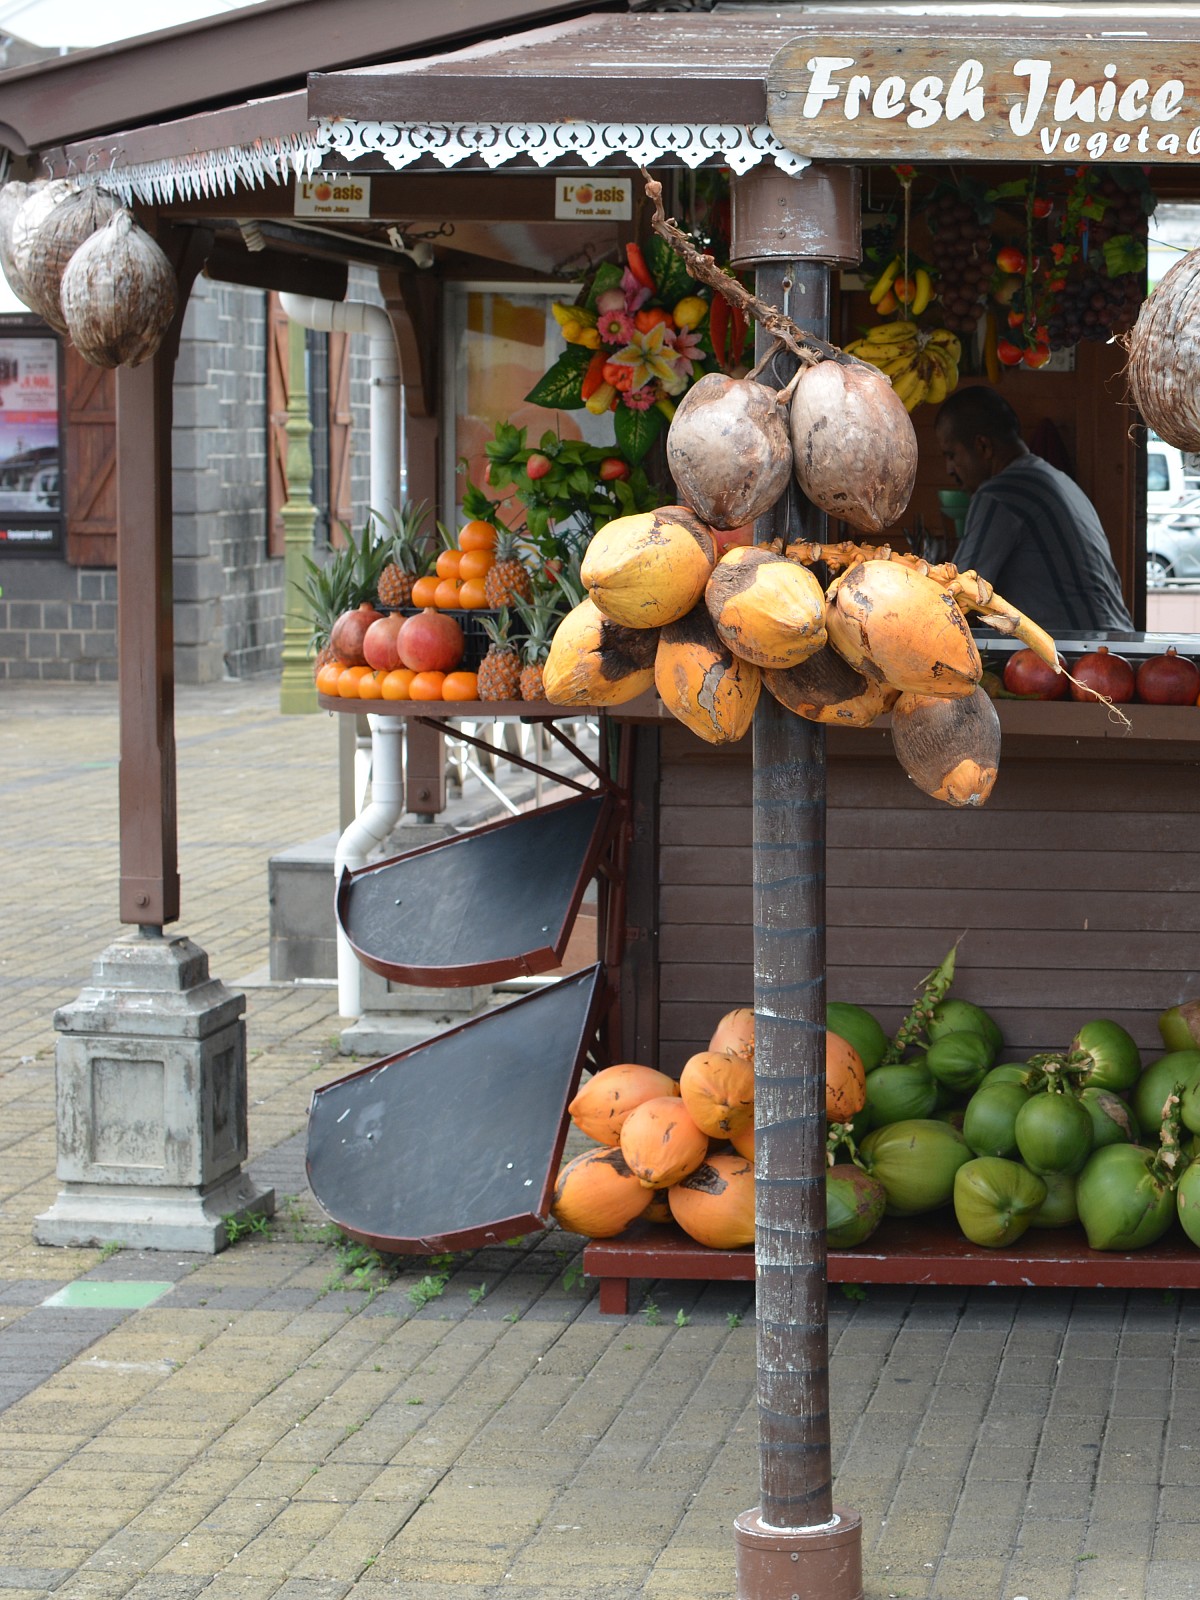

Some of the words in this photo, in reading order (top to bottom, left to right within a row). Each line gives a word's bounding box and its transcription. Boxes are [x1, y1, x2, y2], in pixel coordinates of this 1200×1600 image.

[803, 57, 986, 128] Fresh
[1010, 60, 1184, 137] Juice
[314, 205, 333, 213] Fresh
